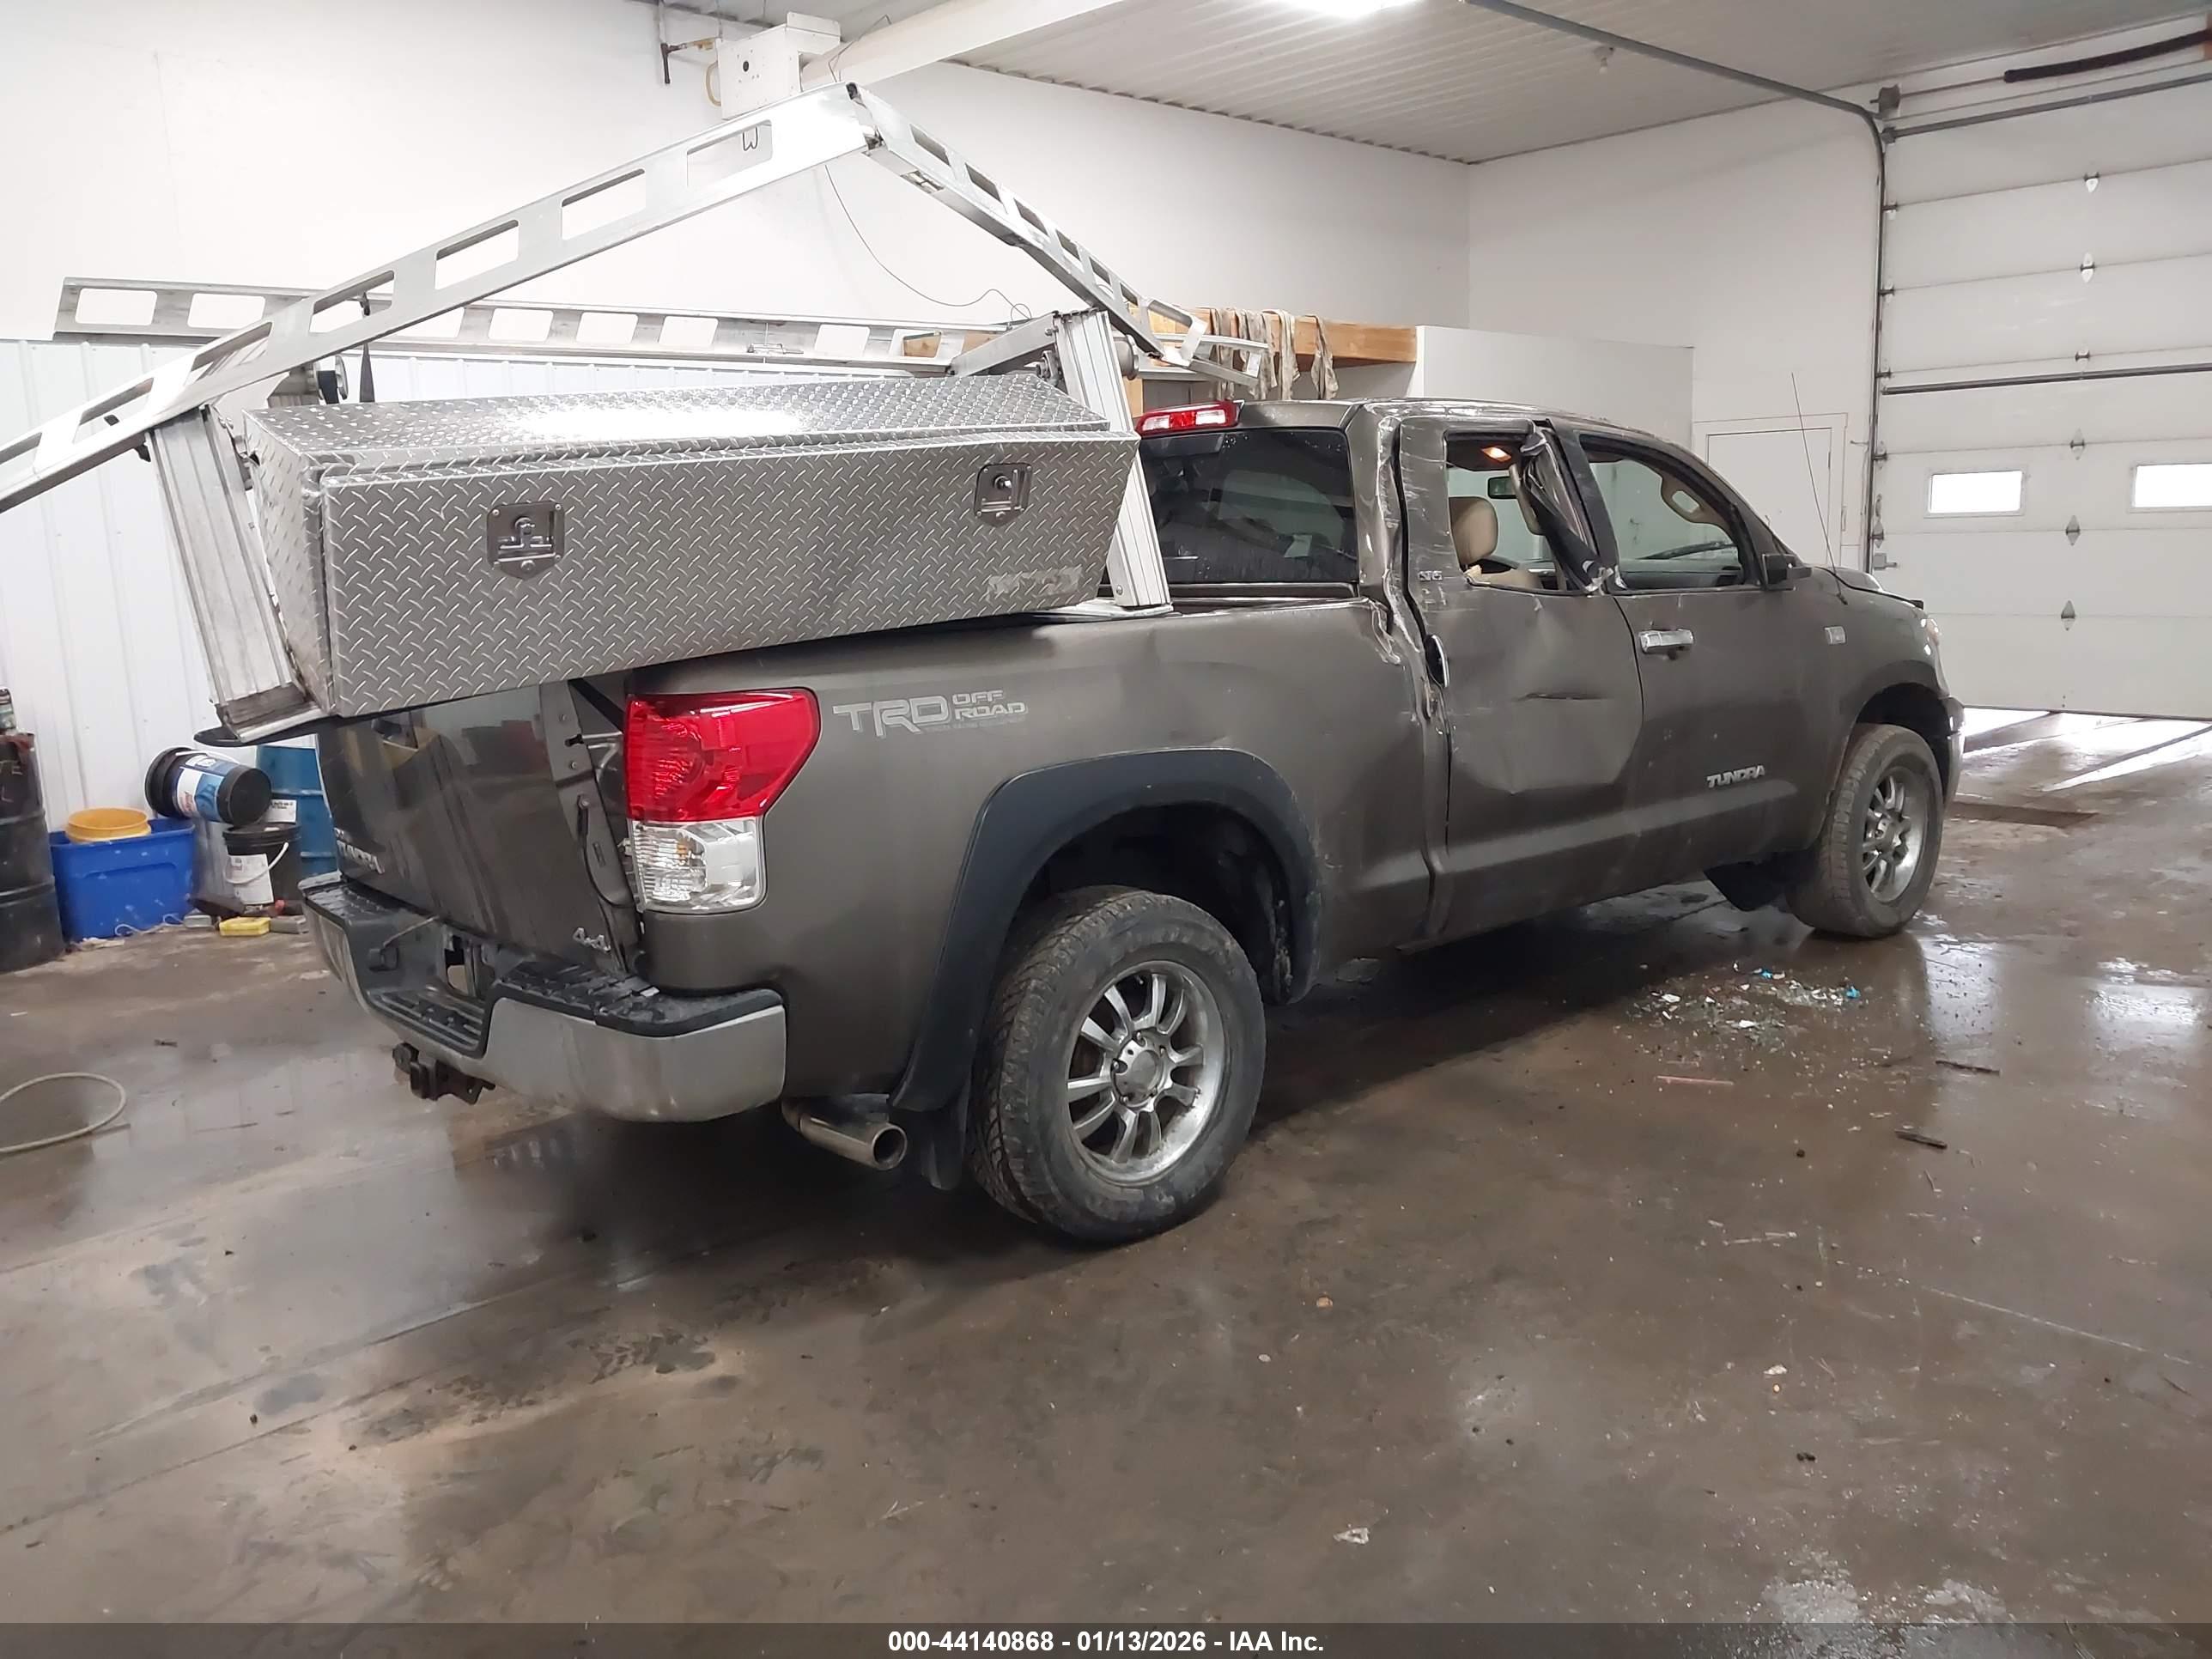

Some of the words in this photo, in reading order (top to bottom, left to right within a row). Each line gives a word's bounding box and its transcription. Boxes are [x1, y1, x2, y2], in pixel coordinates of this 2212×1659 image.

[952, 690, 1005, 705] OFF
[832, 695, 950, 738] TRD
[954, 702, 1027, 720] ROAD
[1706, 765, 1765, 788] TUNDRA
